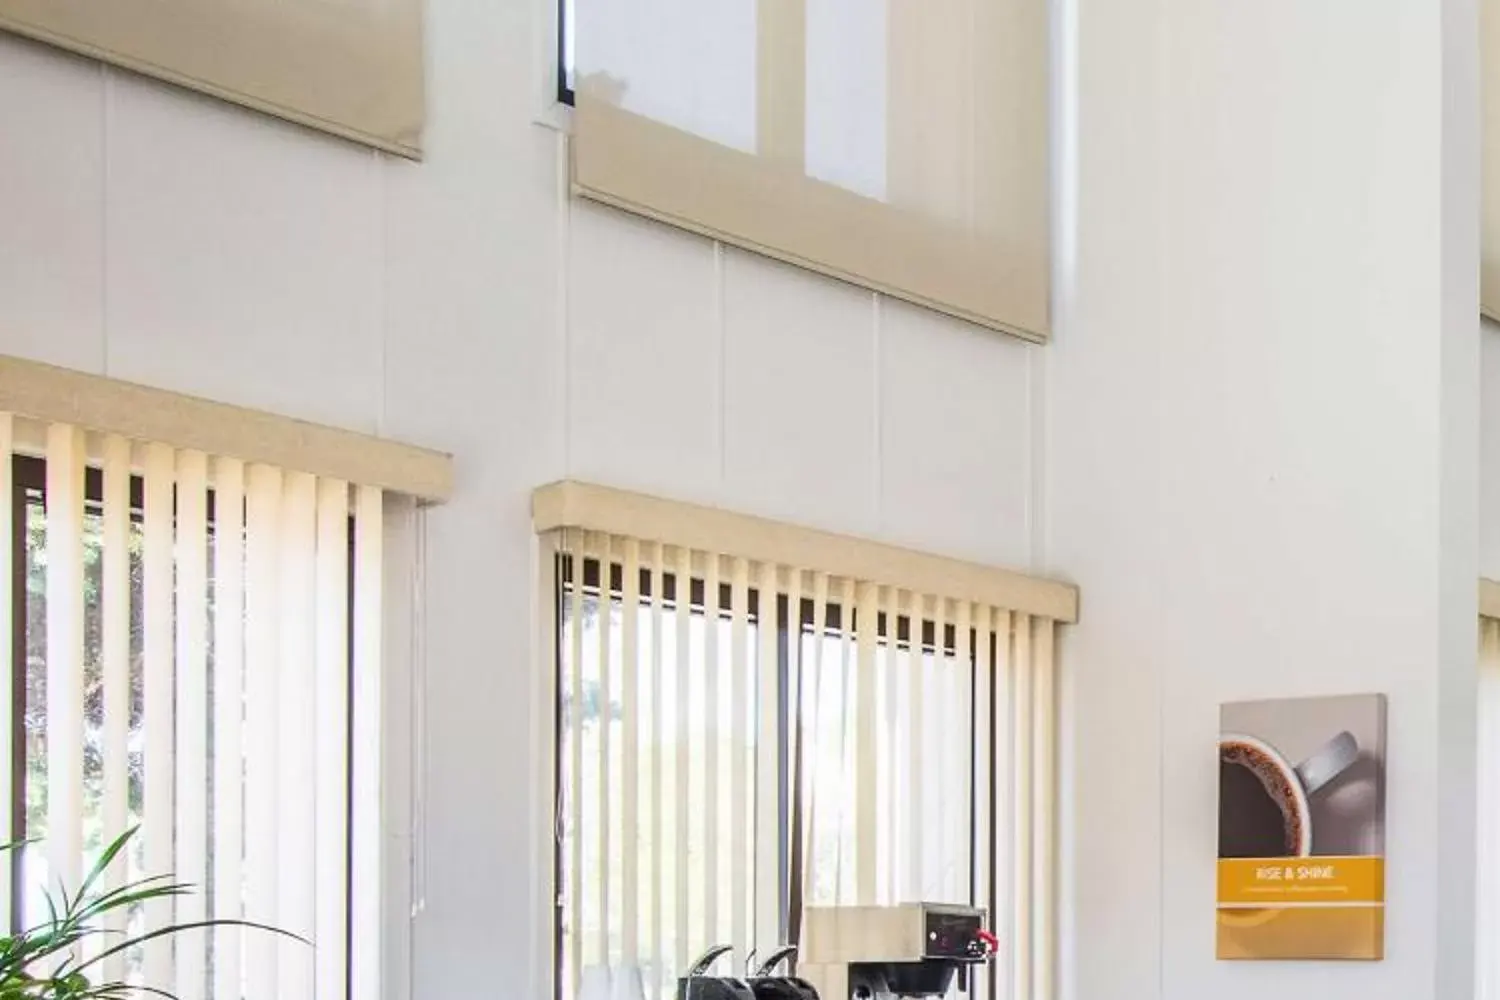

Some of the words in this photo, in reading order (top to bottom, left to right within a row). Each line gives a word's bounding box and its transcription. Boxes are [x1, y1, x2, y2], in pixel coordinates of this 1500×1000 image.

[1256, 867, 1281, 880] RISE
[1285, 866, 1294, 879] &
[1297, 865, 1334, 879] SHINE
